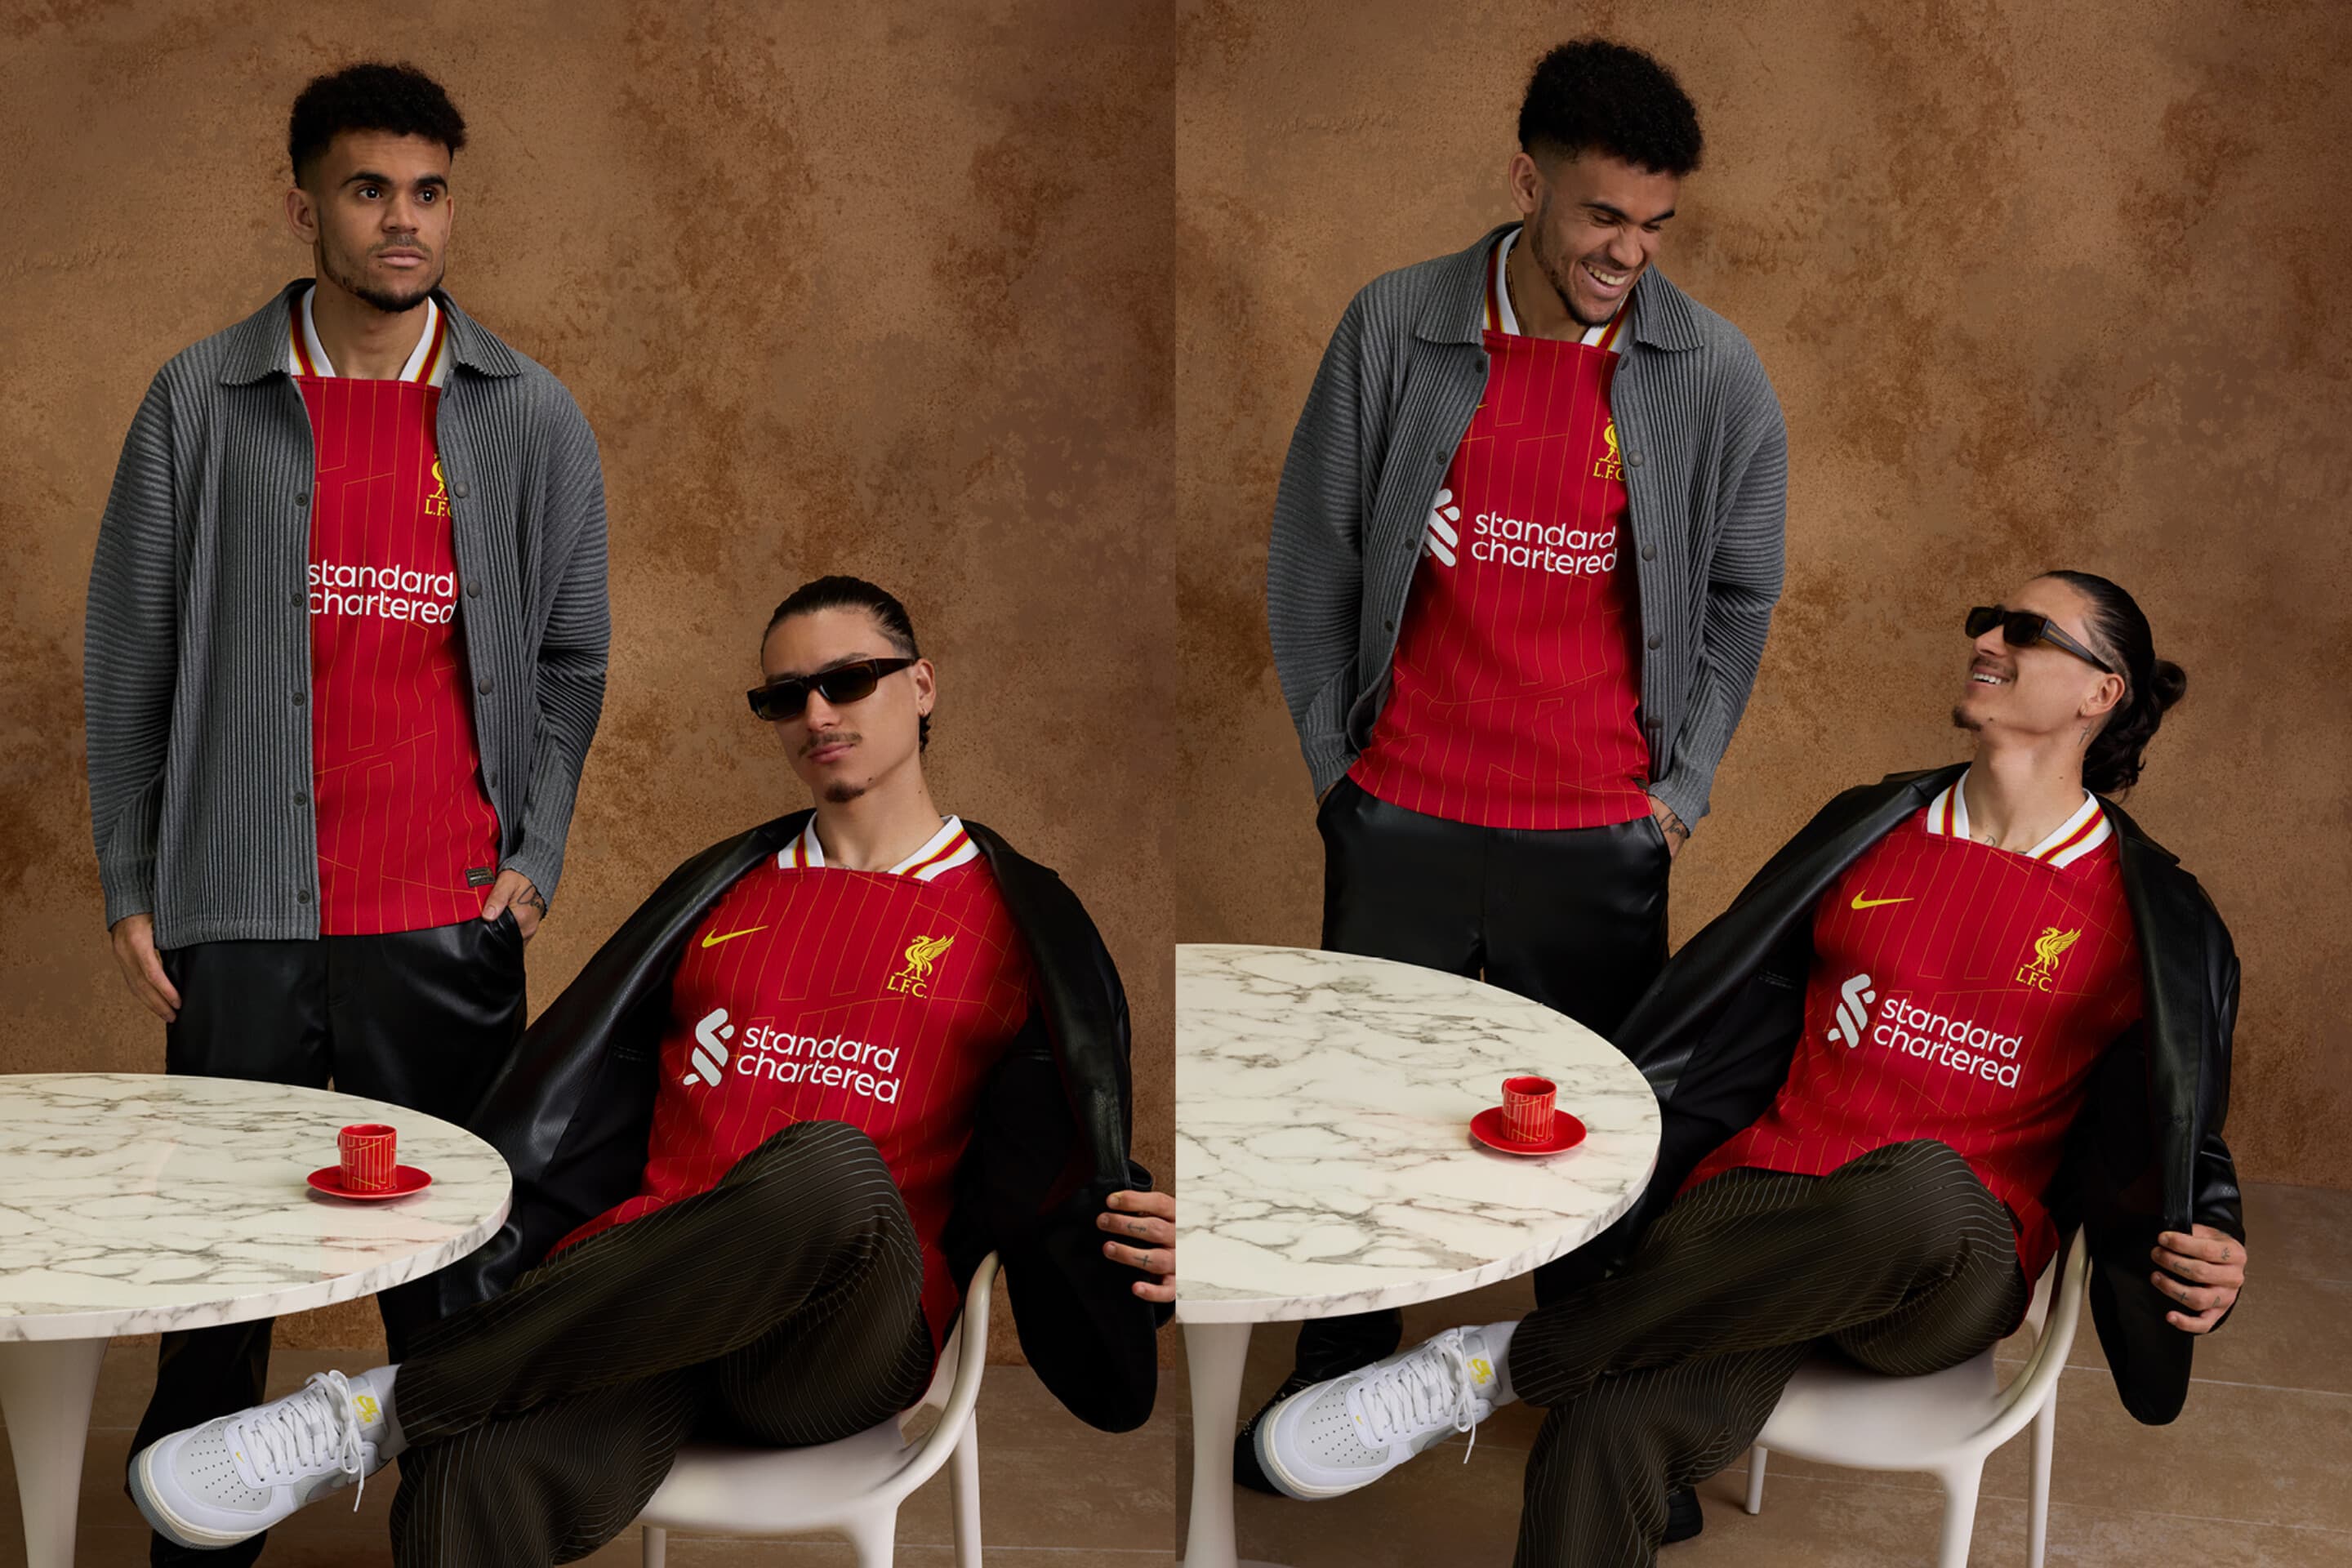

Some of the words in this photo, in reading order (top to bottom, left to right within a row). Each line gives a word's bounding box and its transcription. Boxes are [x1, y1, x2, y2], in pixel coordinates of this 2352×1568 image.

[1473, 510, 1616, 550] standard
[308, 559, 455, 599] standard
[1471, 538, 1618, 576] chartered
[309, 587, 457, 625] chartered
[742, 1024, 900, 1075] standard
[1881, 998, 2024, 1060] standard
[736, 1051, 900, 1105] chartered
[1873, 1024, 2021, 1089] chartered
